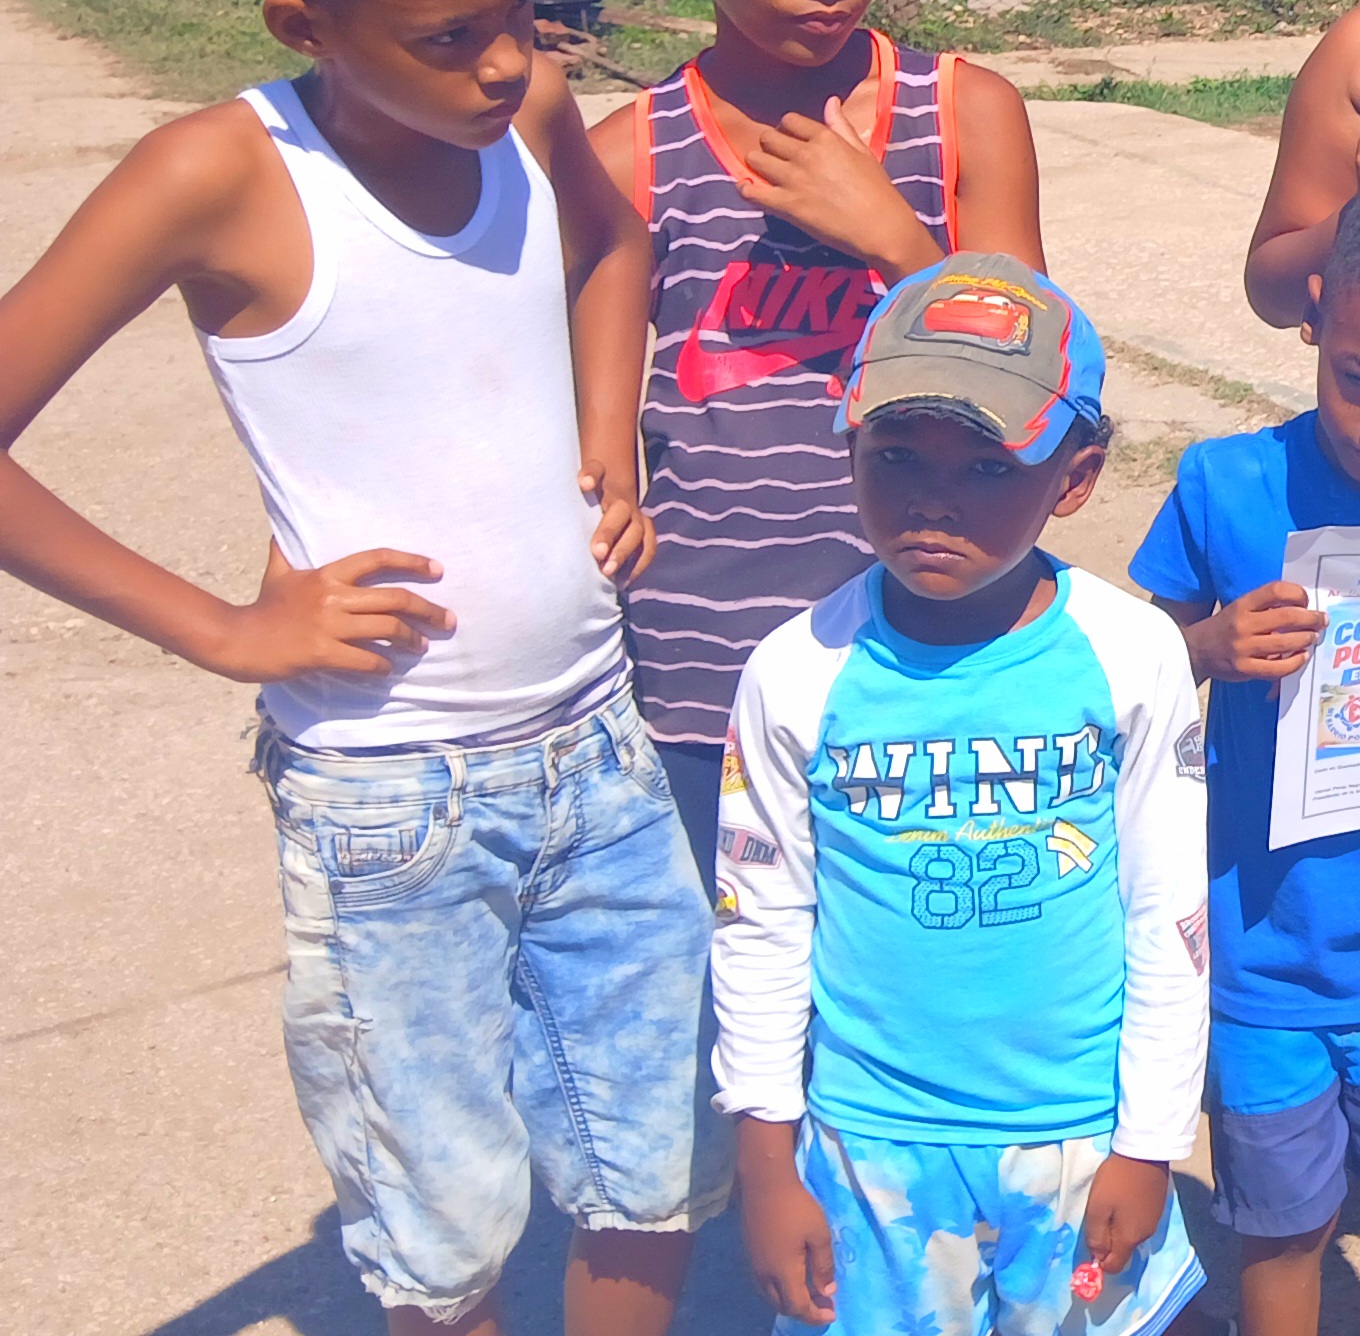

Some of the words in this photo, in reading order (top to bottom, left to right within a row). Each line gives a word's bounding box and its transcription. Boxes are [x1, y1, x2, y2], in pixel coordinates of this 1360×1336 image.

[701, 262, 879, 332] NIKE
[827, 724, 1107, 821] WIND
[908, 837, 1042, 930] 82
